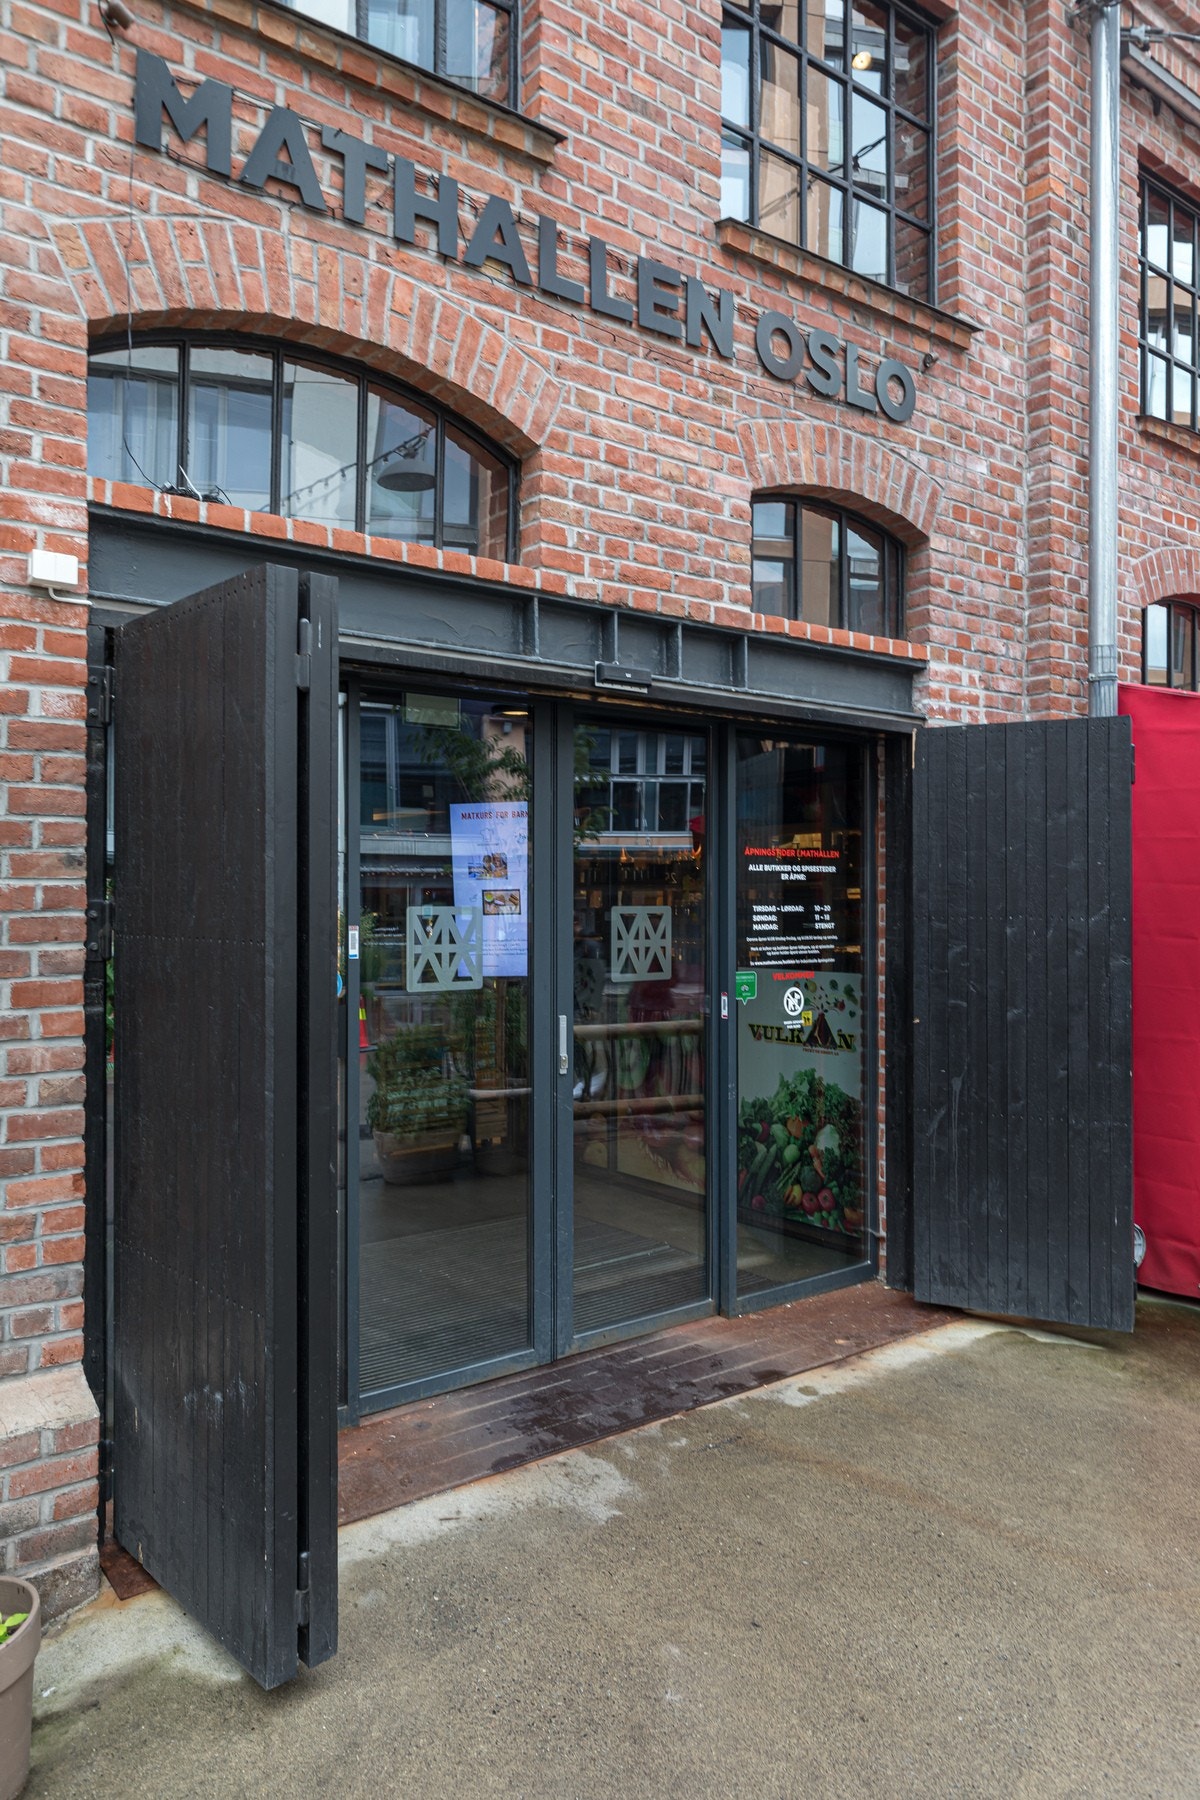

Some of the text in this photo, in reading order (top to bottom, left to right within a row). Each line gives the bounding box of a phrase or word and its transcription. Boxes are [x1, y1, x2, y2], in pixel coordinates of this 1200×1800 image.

[134, 50, 917, 422] MATHALLEN OSLO
[461, 811, 493, 820] MATKURS
[744, 847, 795, 857] ÅPNINGSTIDER
[800, 849, 840, 858] MATHALLEN
[748, 864, 836, 873] ALLE BUTIKKER OG SPISESTEDER
[753, 914, 777, 922] SØNDAG:
[773, 971, 814, 980] VELKOMMEN
